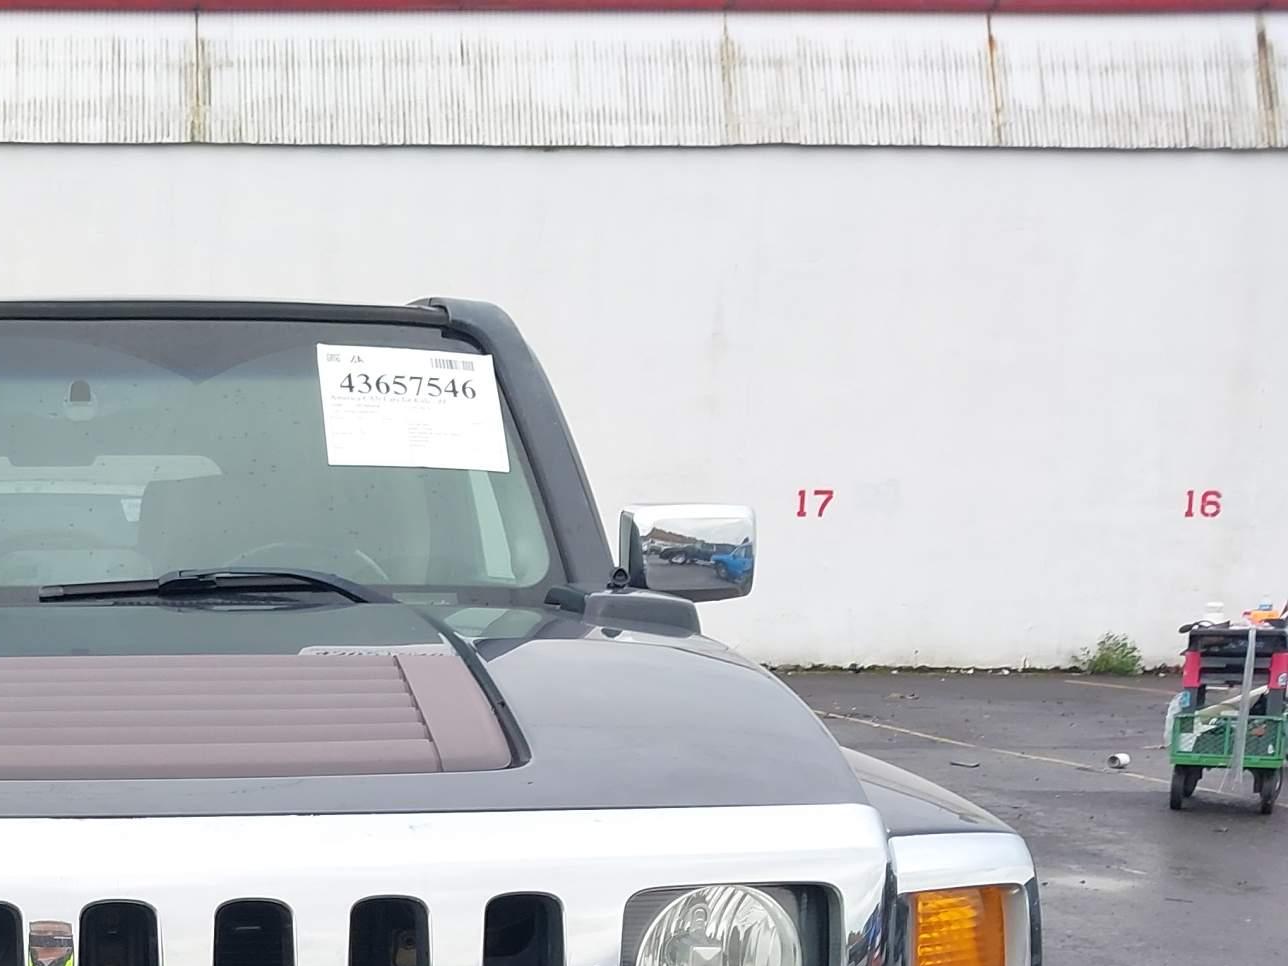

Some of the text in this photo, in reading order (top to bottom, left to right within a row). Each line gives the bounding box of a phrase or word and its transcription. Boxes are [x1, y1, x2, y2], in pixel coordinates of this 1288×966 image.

[339, 372, 477, 400] 43657546
[796, 489, 834, 518] 17
[1184, 490, 1222, 518] 16
